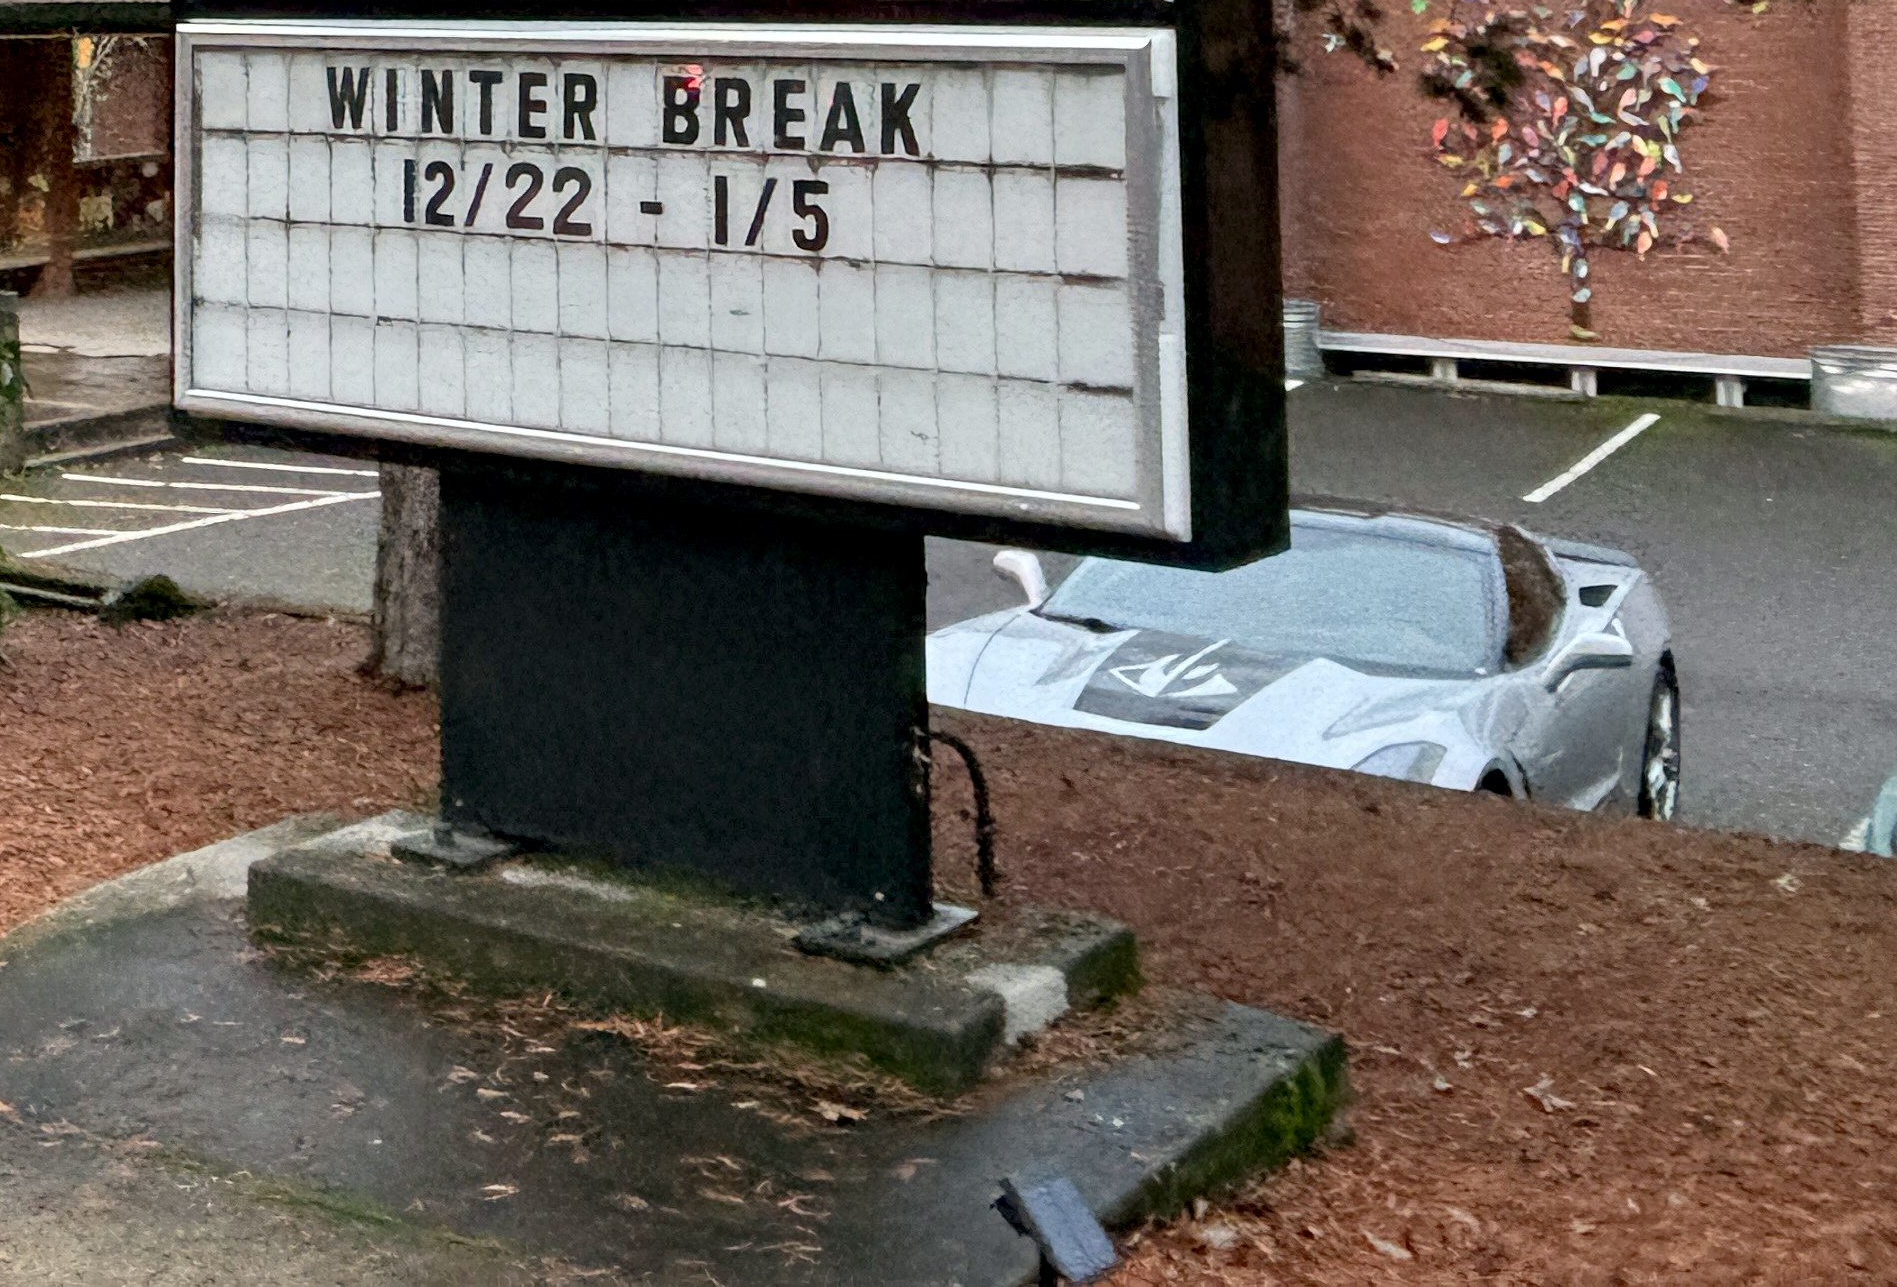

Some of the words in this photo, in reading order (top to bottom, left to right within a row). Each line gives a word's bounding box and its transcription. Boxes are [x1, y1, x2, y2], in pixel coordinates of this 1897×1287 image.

[325, 65, 599, 141] WINTER
[661, 74, 923, 159] BREAK
[402, 158, 594, 238] 12/22
[713, 176, 830, 252] 1/5
